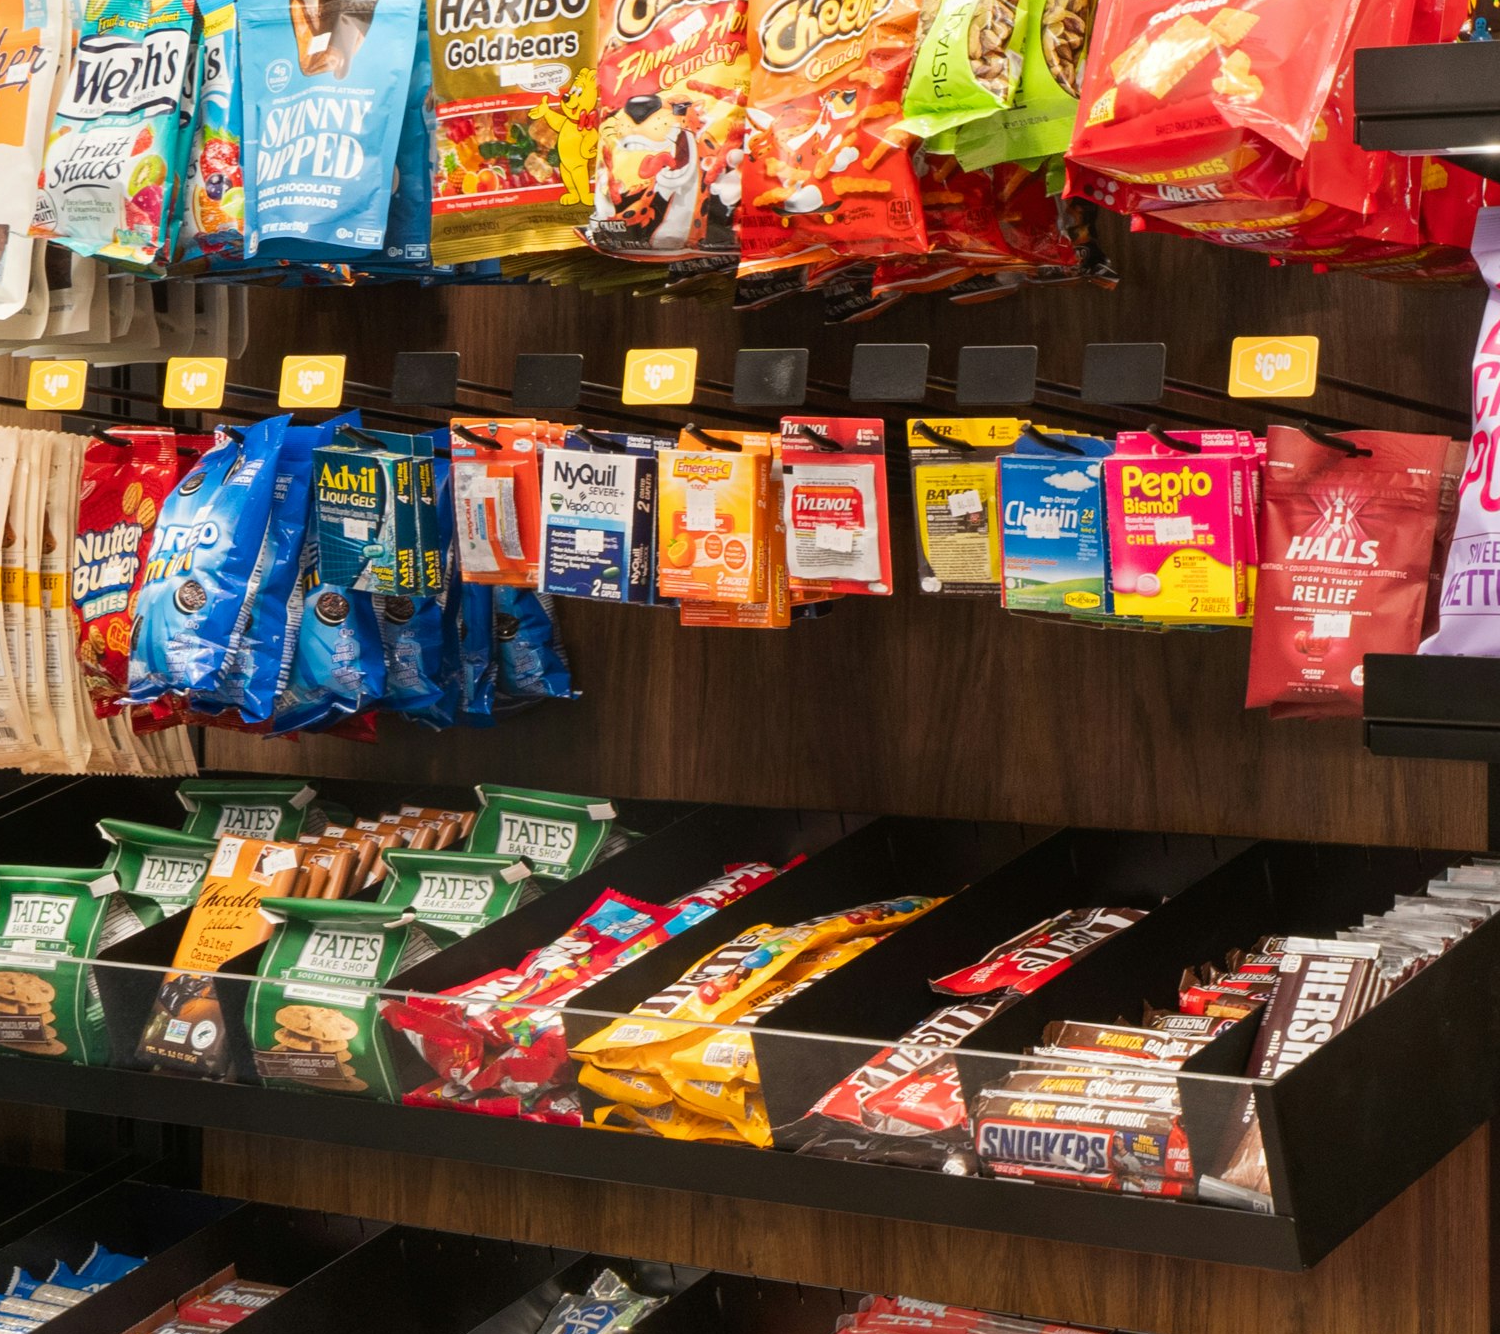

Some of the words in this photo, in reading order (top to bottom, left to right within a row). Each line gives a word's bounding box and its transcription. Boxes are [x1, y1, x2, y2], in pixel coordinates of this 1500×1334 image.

[447, 30, 579, 70] Goldbears
[660, 40, 740, 89] Crunchy
[261, 97, 372, 148] SKINNY
[73, 138, 128, 161] Fruit
[257, 132, 364, 186] DIPPED
[49, 159, 122, 190] Snacks
[277, 183, 341, 195] CHOCOLATE
[282, 196, 338, 209] ALMONDS
[318, 463, 378, 493] Advil
[554, 461, 616, 487] NyQuil
[677, 462, 728, 476] Emergen-C
[1122, 466, 1212, 502] Pepto
[320, 489, 376, 508] LIQUI-GELS
[565, 498, 620, 515] VapoCOOL
[795, 494, 852, 512] TYLENOL
[1124, 496, 1179, 514] Bismol
[1004, 501, 1078, 530] Claritin
[76, 524, 142, 567] Nutter
[144, 550, 193, 582] mini
[85, 594, 128, 618] BITES
[1292, 585, 1356, 605] RELIEF
[12, 896, 72, 926] TATE'S
[311, 931, 382, 963] TATE'S
[310, 957, 339, 970] BAKE
[342, 959, 369, 973] SHOP
[1106, 1110, 1149, 1129] NOUGAT.
[982, 1125, 1106, 1169] SNICKERS
